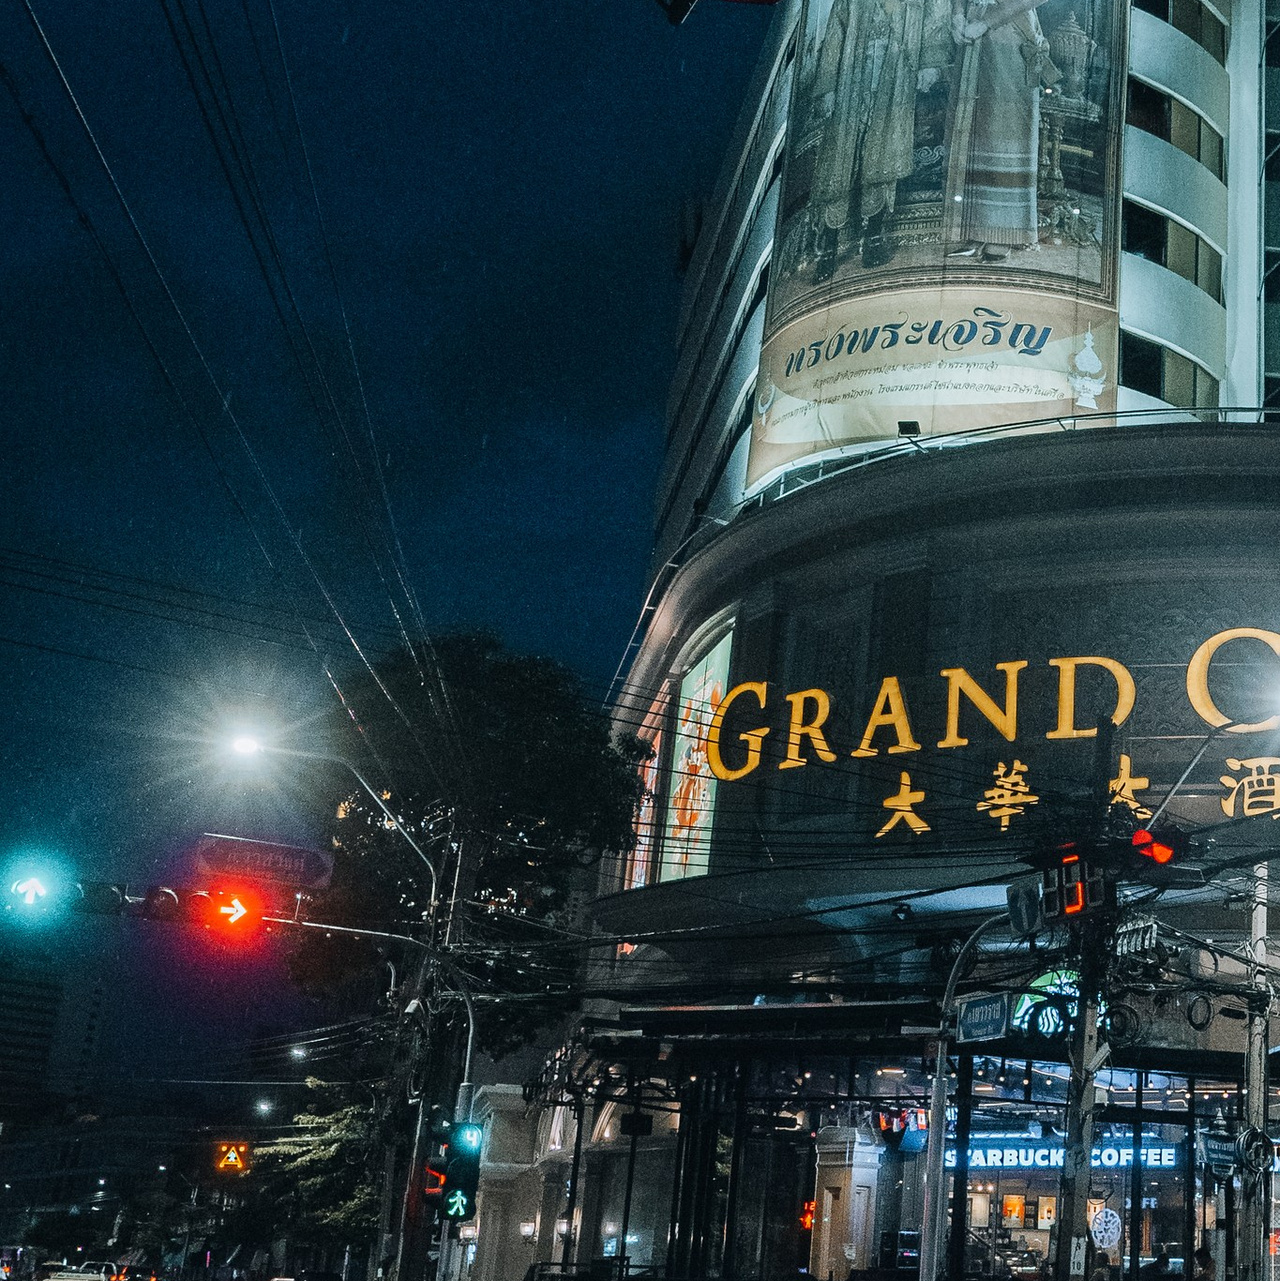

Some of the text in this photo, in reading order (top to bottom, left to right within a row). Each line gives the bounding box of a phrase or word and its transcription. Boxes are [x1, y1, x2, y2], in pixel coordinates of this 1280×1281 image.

[785, 307, 1053, 378] ทรงพระเจริญ
[706, 656, 1134, 781] GRAND
